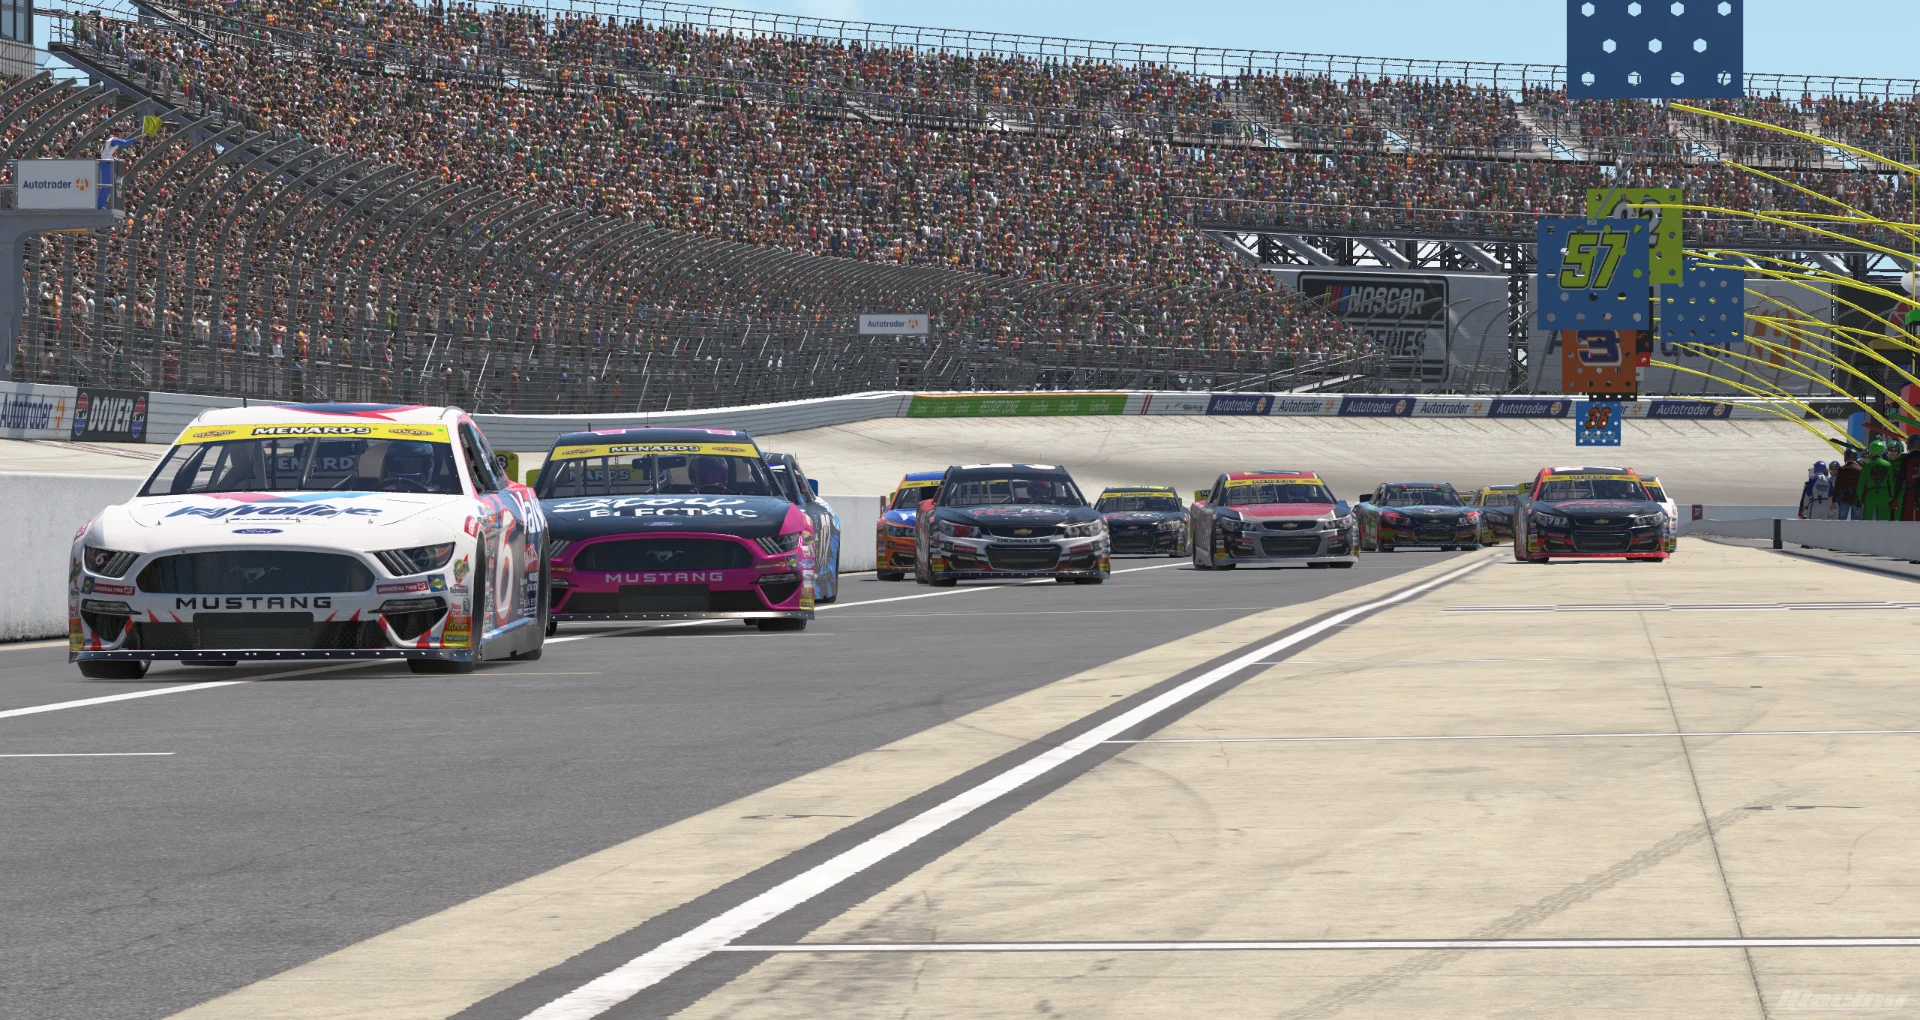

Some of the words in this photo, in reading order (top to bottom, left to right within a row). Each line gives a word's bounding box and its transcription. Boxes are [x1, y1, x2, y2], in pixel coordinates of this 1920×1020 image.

[23, 180, 72, 189] Autotrader
[1558, 230, 1630, 290] 57
[1347, 286, 1425, 314] NASCAR
[867, 320, 905, 328] Autotrader
[1576, 330, 1622, 366] 3
[1, 392, 53, 430] Autotrader
[1213, 399, 1255, 412] Autotrader
[1278, 399, 1323, 412] Autotrader
[1346, 400, 1393, 413] Autotrader
[1420, 401, 1470, 414] Autotrader
[1497, 401, 1548, 414] Autotrader
[1656, 404, 1711, 416] Autotrader
[1819, 405, 1845, 415] xfinity
[87, 396, 134, 433] DOVER
[1585, 406, 1611, 430] 38
[252, 426, 372, 436] MENARDS
[610, 445, 700, 453] MENARDS
[590, 508, 759, 518] ELECTRIC
[496, 509, 516, 629] 6
[605, 572, 723, 583] MUSTANG
[378, 585, 404, 593] GENERAL
[176, 596, 332, 610] MUSTANG
